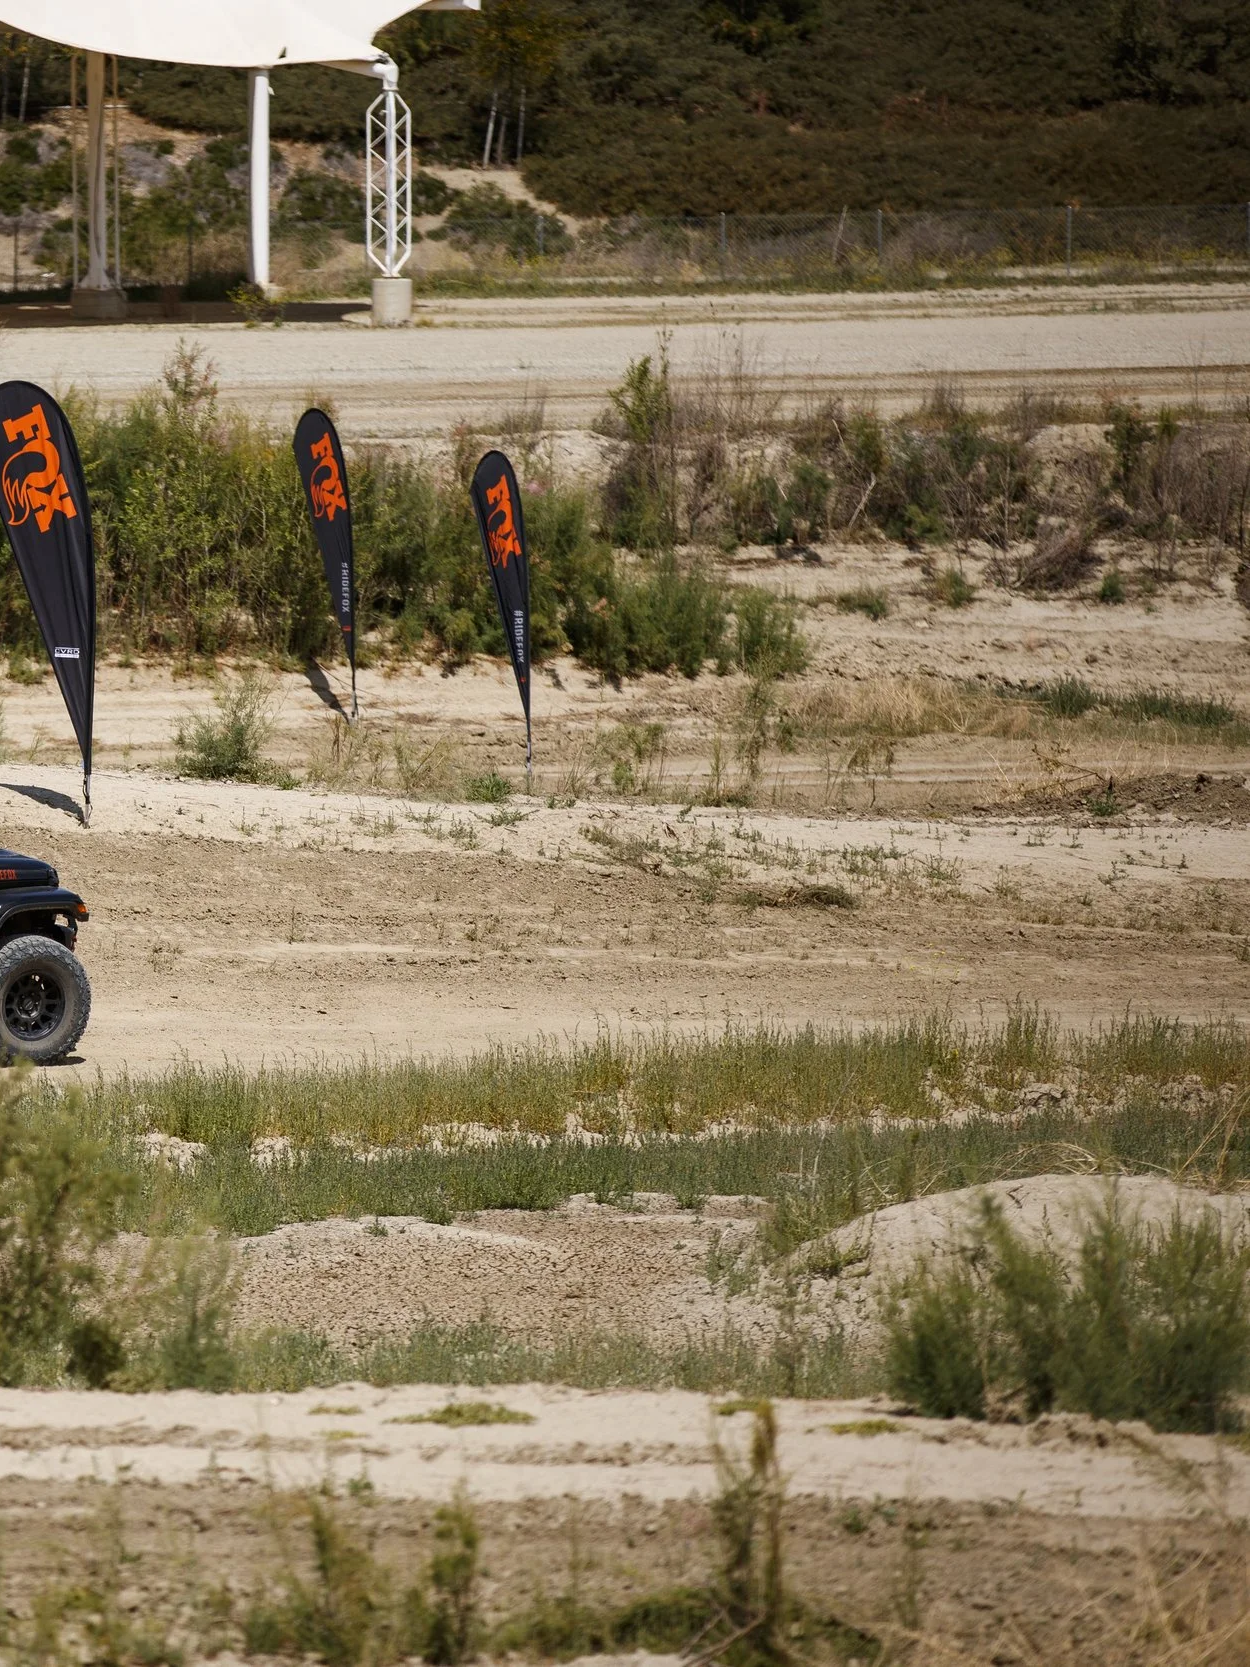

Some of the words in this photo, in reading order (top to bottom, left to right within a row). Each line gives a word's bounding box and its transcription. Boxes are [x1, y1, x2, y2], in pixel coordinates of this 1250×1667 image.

[3, 404, 77, 533] FOX
[310, 432, 347, 521] FOX
[486, 474, 522, 569] FOX
